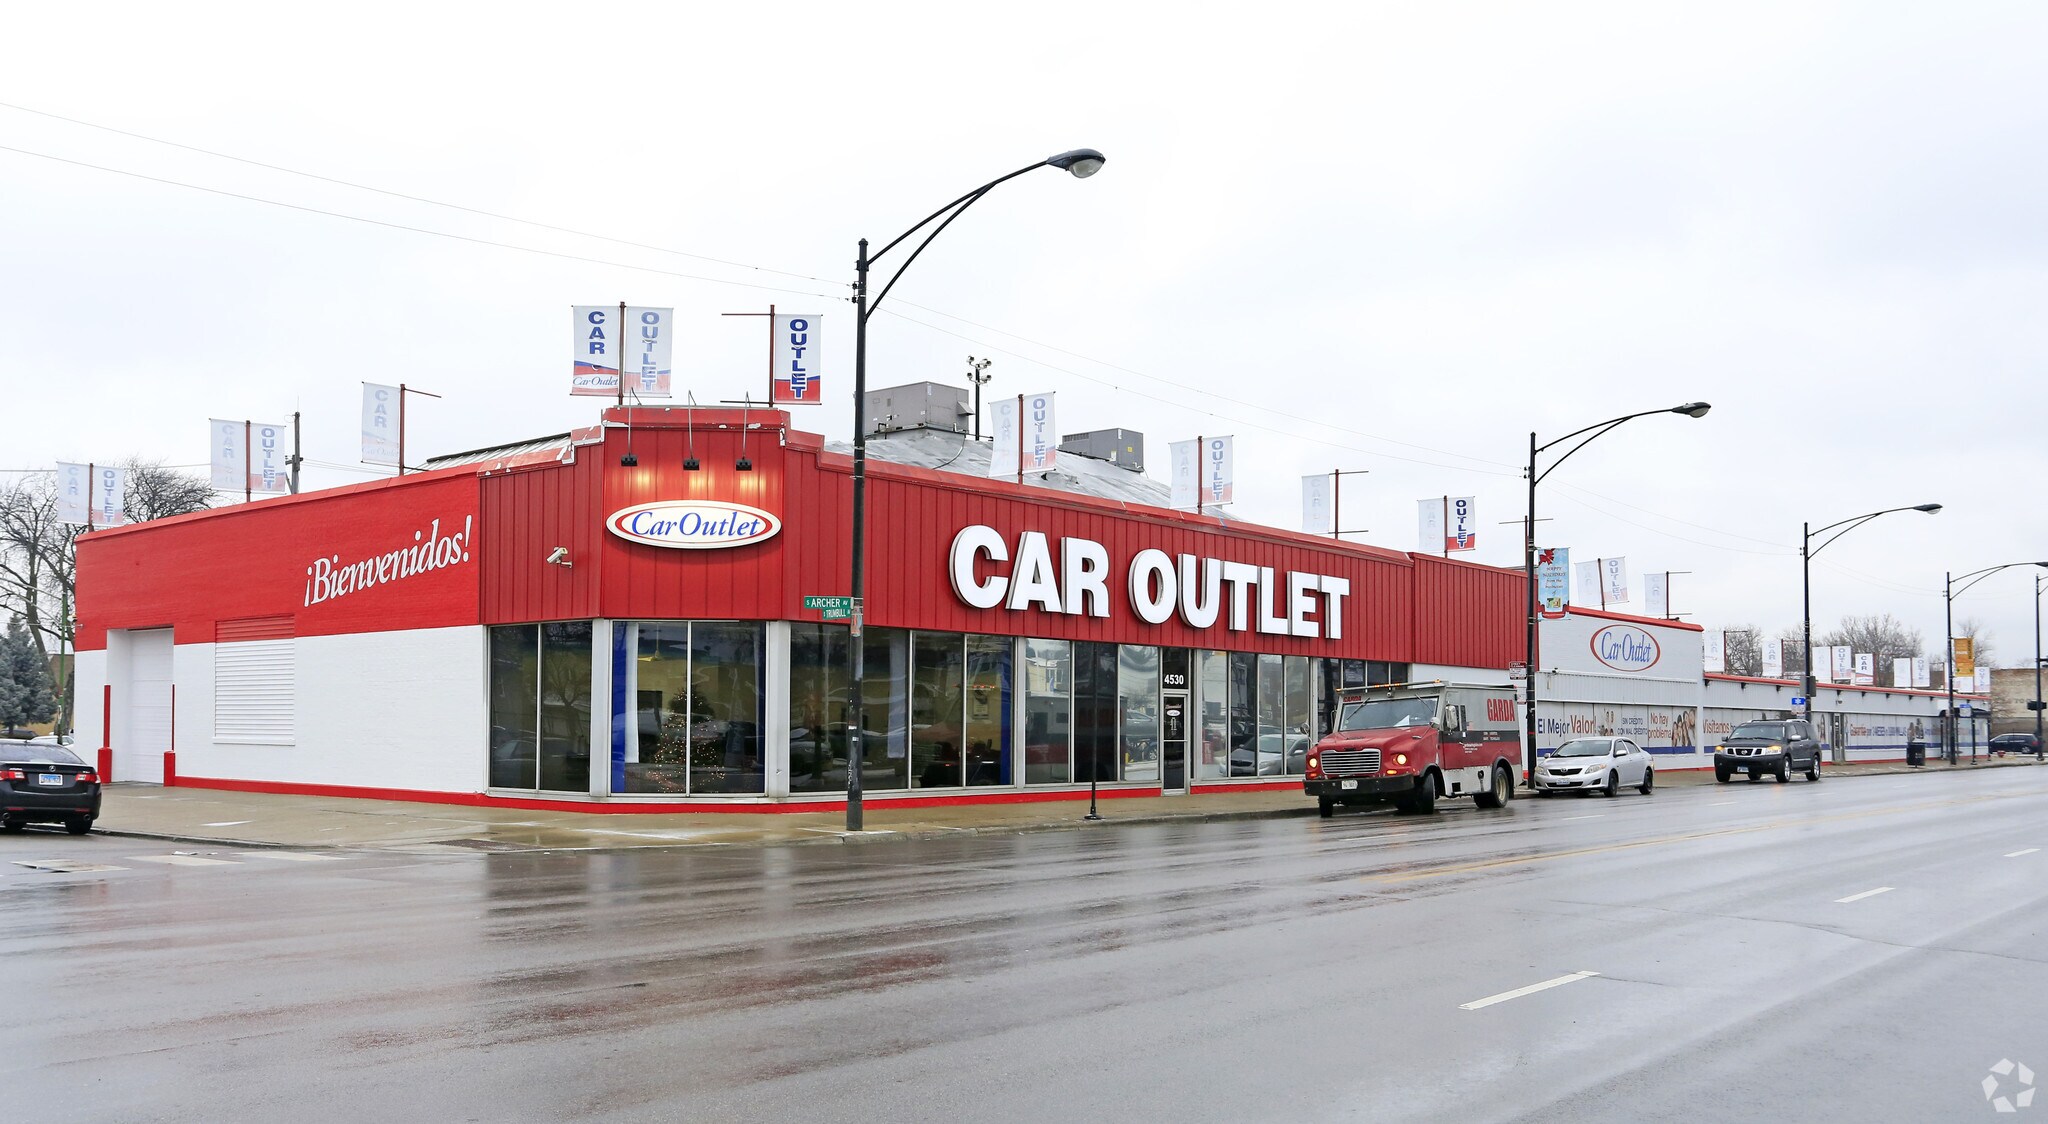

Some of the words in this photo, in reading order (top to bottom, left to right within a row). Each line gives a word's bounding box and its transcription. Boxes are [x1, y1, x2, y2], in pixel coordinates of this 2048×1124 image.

[588, 311, 605, 354] CAR
[641, 312, 660, 391] OUTLET
[789, 319, 808, 399] OUTLET
[374, 389, 388, 428] CAR
[1032, 398, 1046, 467] OUTLET
[261, 427, 276, 490] OUTLET
[1211, 440, 1224, 501] OUTLET
[103, 470, 116, 523] OUTLET
[1455, 499, 1467, 548] OUTLET
[304, 515, 473, 607] ¡Bienvenidos!
[949, 524, 1110, 618] CAR
[1127, 548, 1351, 640] OUTLET
[1608, 560, 1620, 600] OUTLET
[811, 598, 840, 607] ARCHER
[826, 608, 846, 618] TRUMBULL
[1164, 674, 1185, 686] 4530
[1486, 698, 1515, 722] GARDA
[1538, 718, 1545, 734] El
[1547, 718, 1570, 738] Mejor
[1570, 714, 1597, 734] Valor!
[1650, 712, 1658, 725] No
[1659, 712, 1668, 727] hay
[1648, 726, 1671, 739] problema
